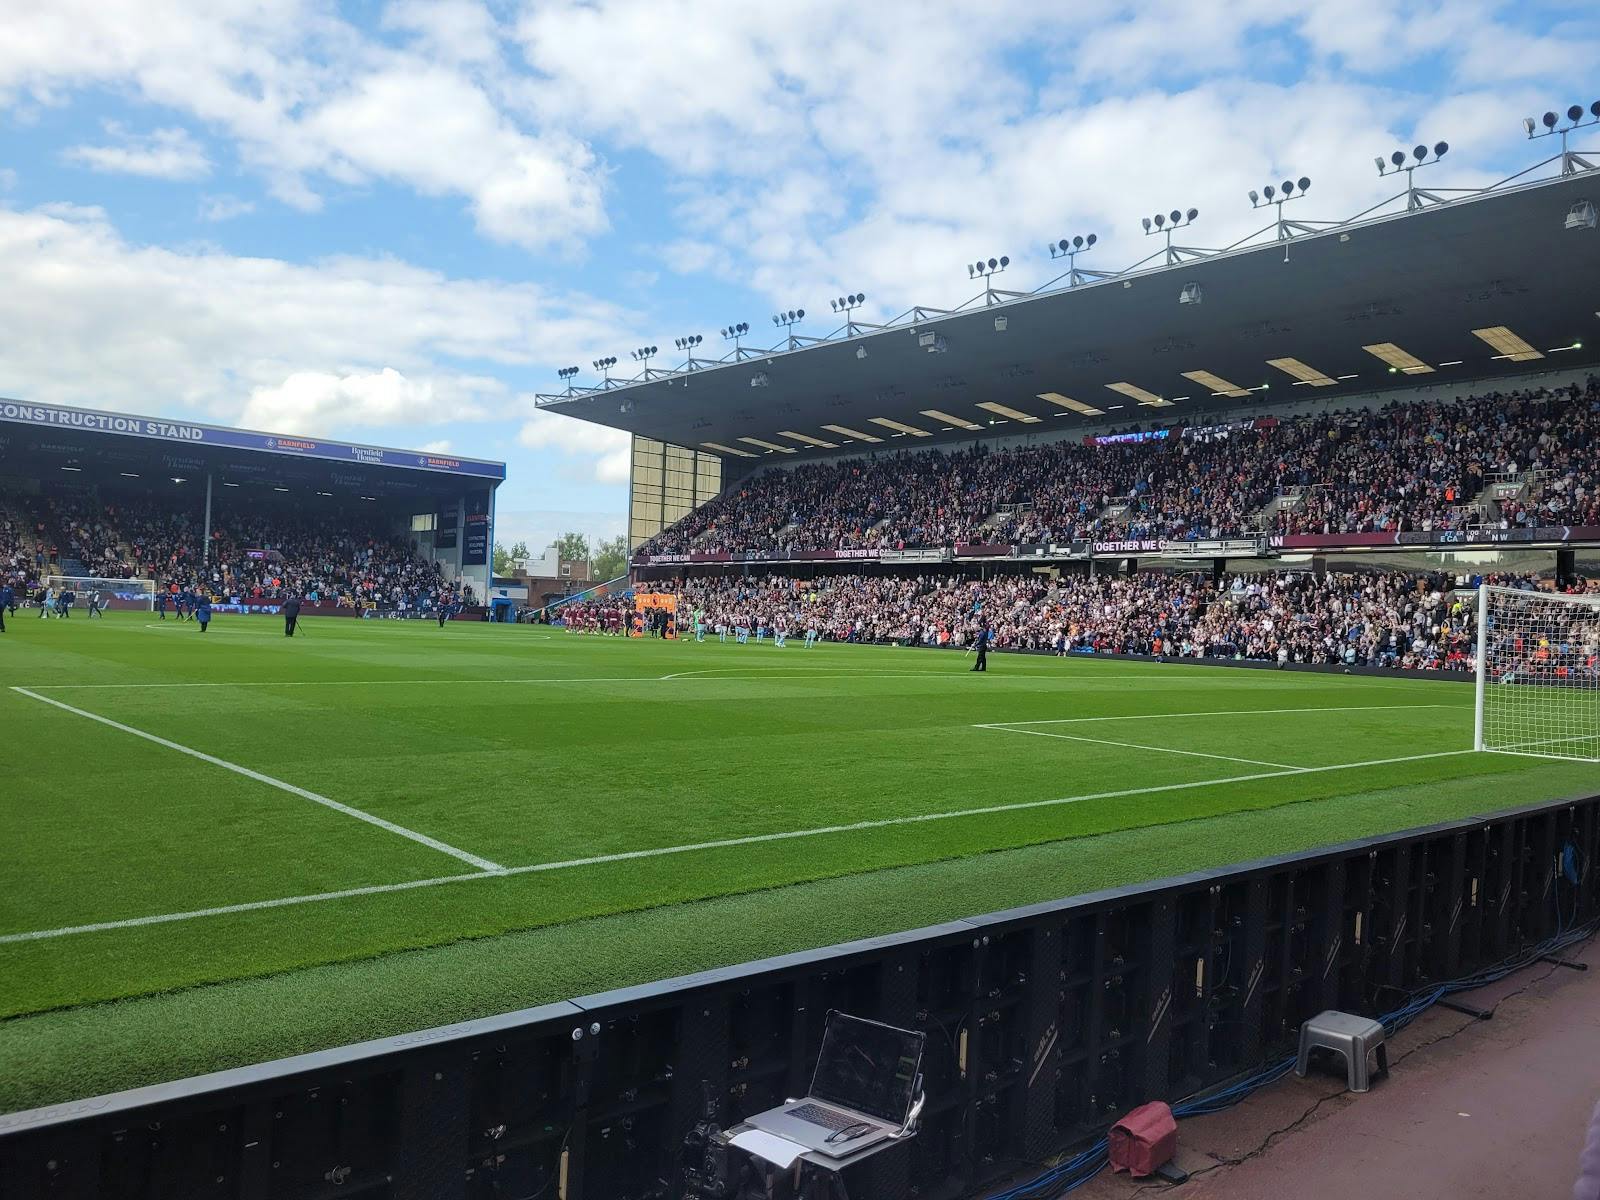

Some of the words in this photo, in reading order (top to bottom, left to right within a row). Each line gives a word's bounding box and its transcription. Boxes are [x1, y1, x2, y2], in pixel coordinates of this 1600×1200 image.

[0, 404, 140, 433] ONSTRUCTION
[146, 422, 203, 440] STAND
[277, 439, 316, 449] BARNFIELD
[351, 447, 383, 458] Barnfield
[357, 454, 381, 462] Homes
[427, 458, 460, 467] BARNFIELD
[1092, 541, 1140, 551] TOGETHER
[1141, 540, 1157, 550] WE
[672, 554, 681, 562] WE
[834, 549, 867, 558] TOGETHER
[868, 549, 879, 557] WE
